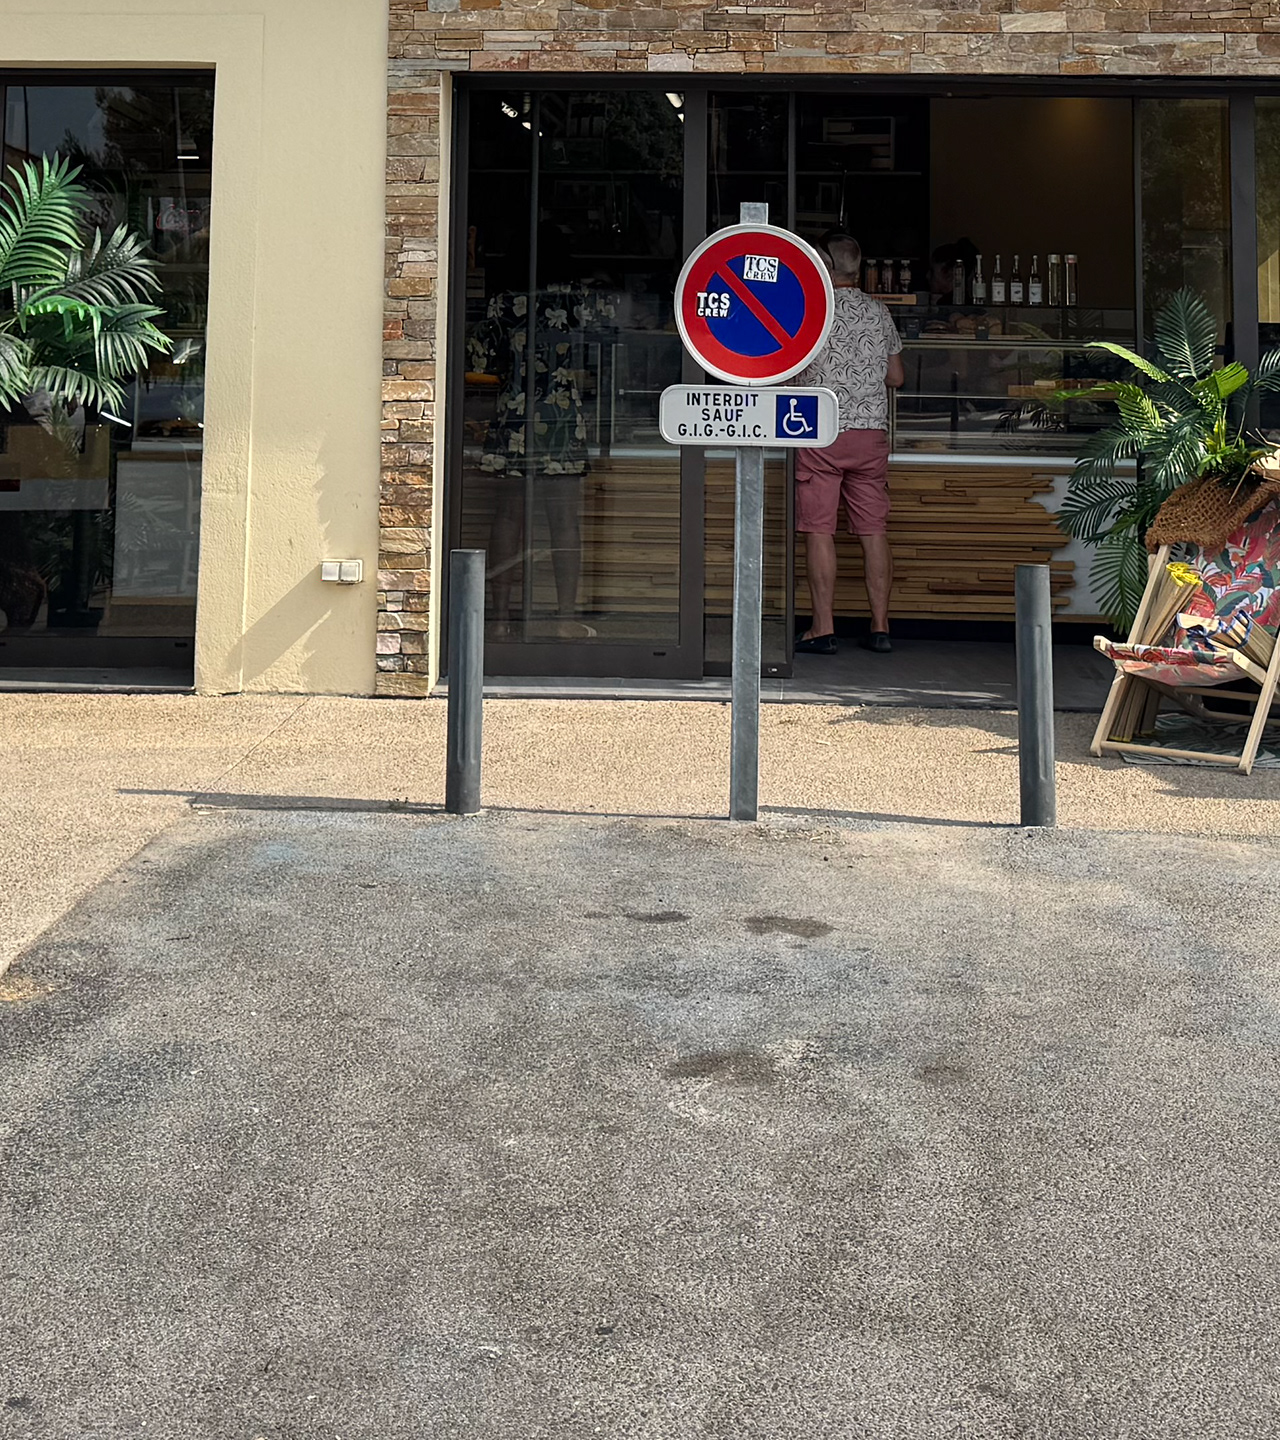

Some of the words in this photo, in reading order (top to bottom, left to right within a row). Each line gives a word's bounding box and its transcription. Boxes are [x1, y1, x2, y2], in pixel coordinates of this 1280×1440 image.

[746, 256, 777, 272] TCS
[745, 270, 776, 282] CREW
[697, 292, 730, 309] TCS
[697, 308, 729, 317] CREW
[686, 392, 759, 407] INTERDIT
[701, 408, 743, 422] SAUF
[678, 423, 767, 439] G.I.G.-G.I.C.
